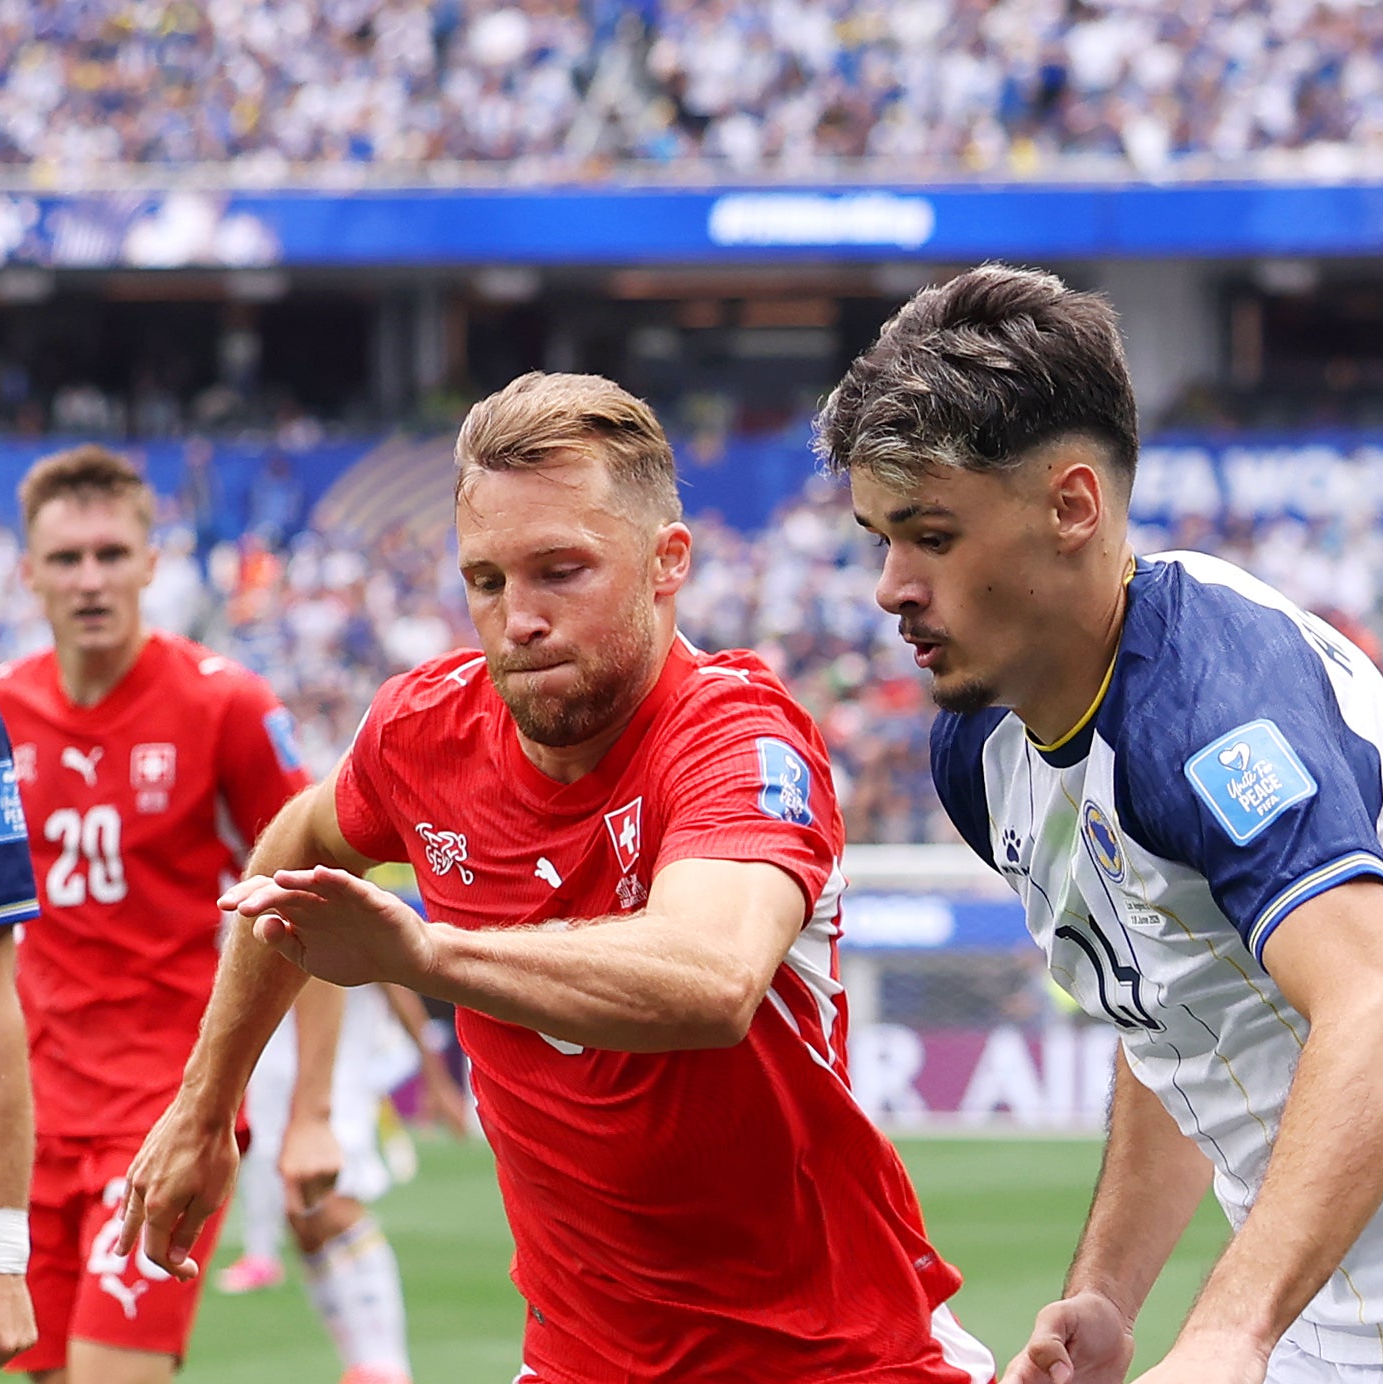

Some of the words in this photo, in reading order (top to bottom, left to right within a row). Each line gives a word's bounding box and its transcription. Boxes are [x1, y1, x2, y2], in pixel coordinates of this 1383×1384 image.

[1238, 773, 1283, 813] PEACE
[1257, 795, 1281, 816] FIFA
[44, 804, 128, 908] 20
